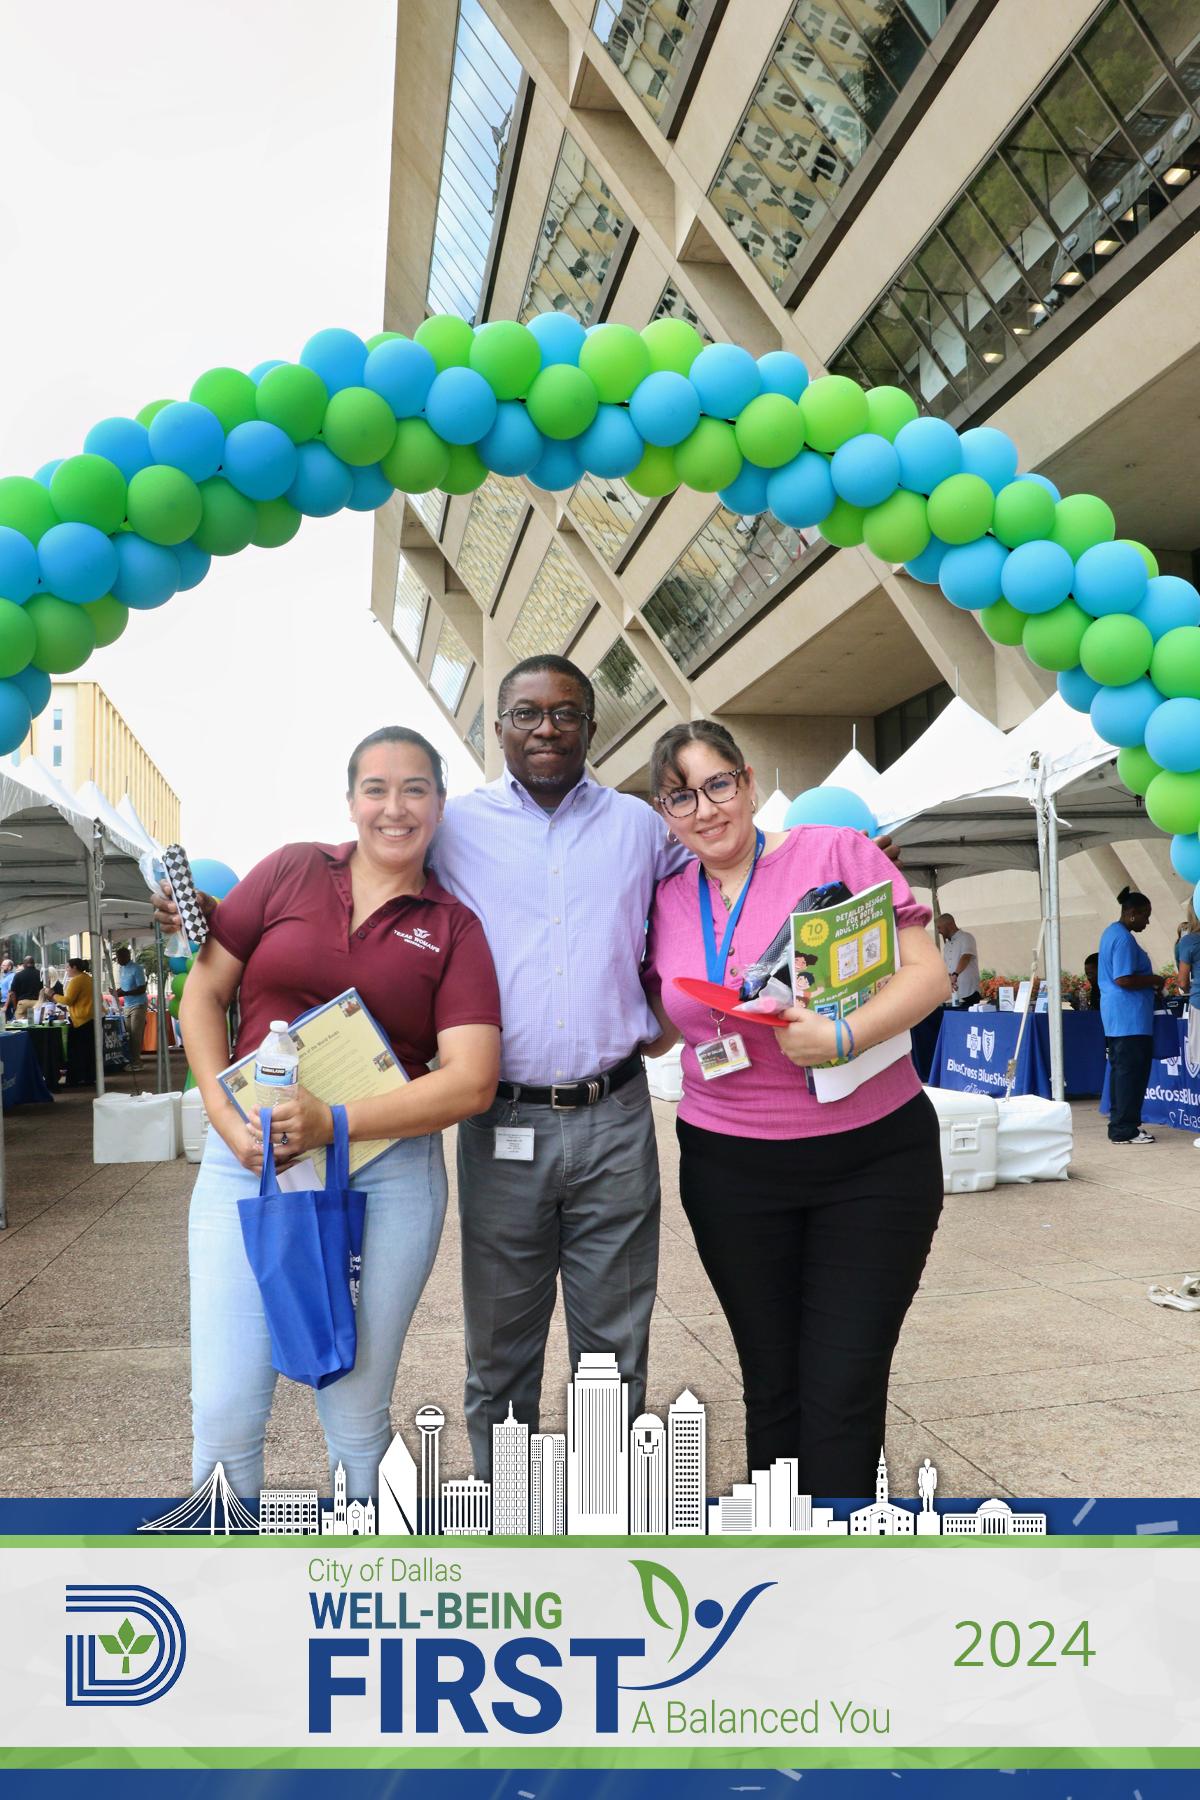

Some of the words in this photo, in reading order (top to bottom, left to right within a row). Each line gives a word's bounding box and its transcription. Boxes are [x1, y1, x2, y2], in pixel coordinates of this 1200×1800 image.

[393, 929, 413, 940] TEXAS
[807, 923, 823, 936] 70
[835, 923, 859, 938] ADULTS
[946, 1058, 978, 1080] BlueCross
[978, 1069, 1016, 1089] BlueShied
[1144, 1085, 1184, 1103] ueCross
